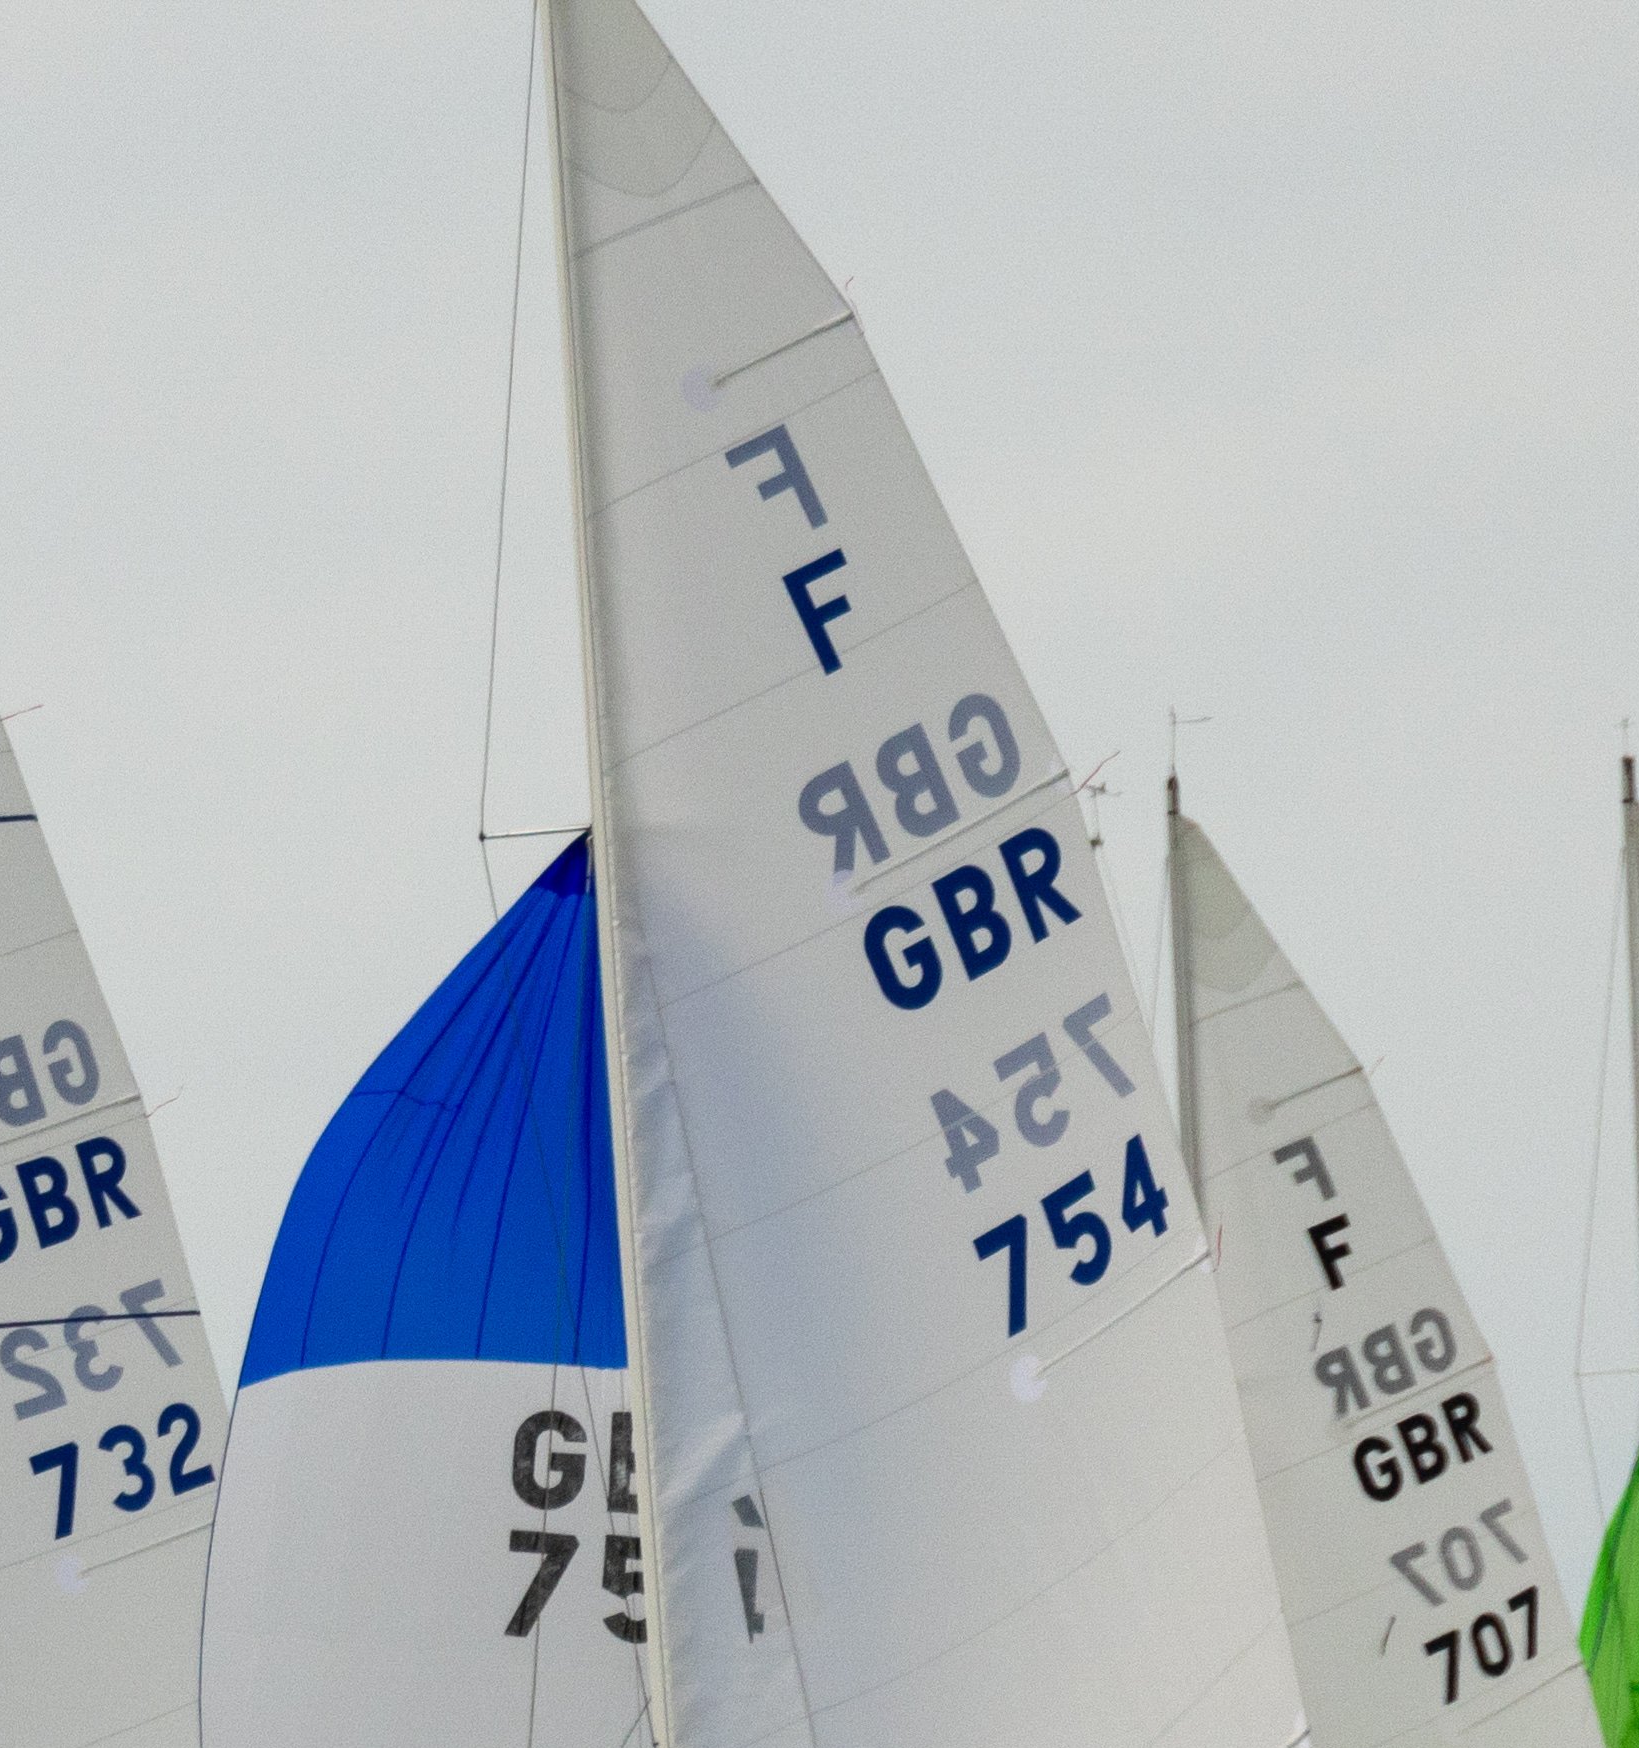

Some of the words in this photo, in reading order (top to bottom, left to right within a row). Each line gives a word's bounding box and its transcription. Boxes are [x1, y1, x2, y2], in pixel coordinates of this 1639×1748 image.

[782, 548, 852, 676] F
[862, 827, 1083, 1011] GBR
[973, 1133, 1169, 1338] 754
[1307, 1213, 1352, 1291] F
[29, 1402, 215, 1540] 732
[1353, 1393, 1493, 1503] GBR
[1425, 1585, 1540, 1705] 707
